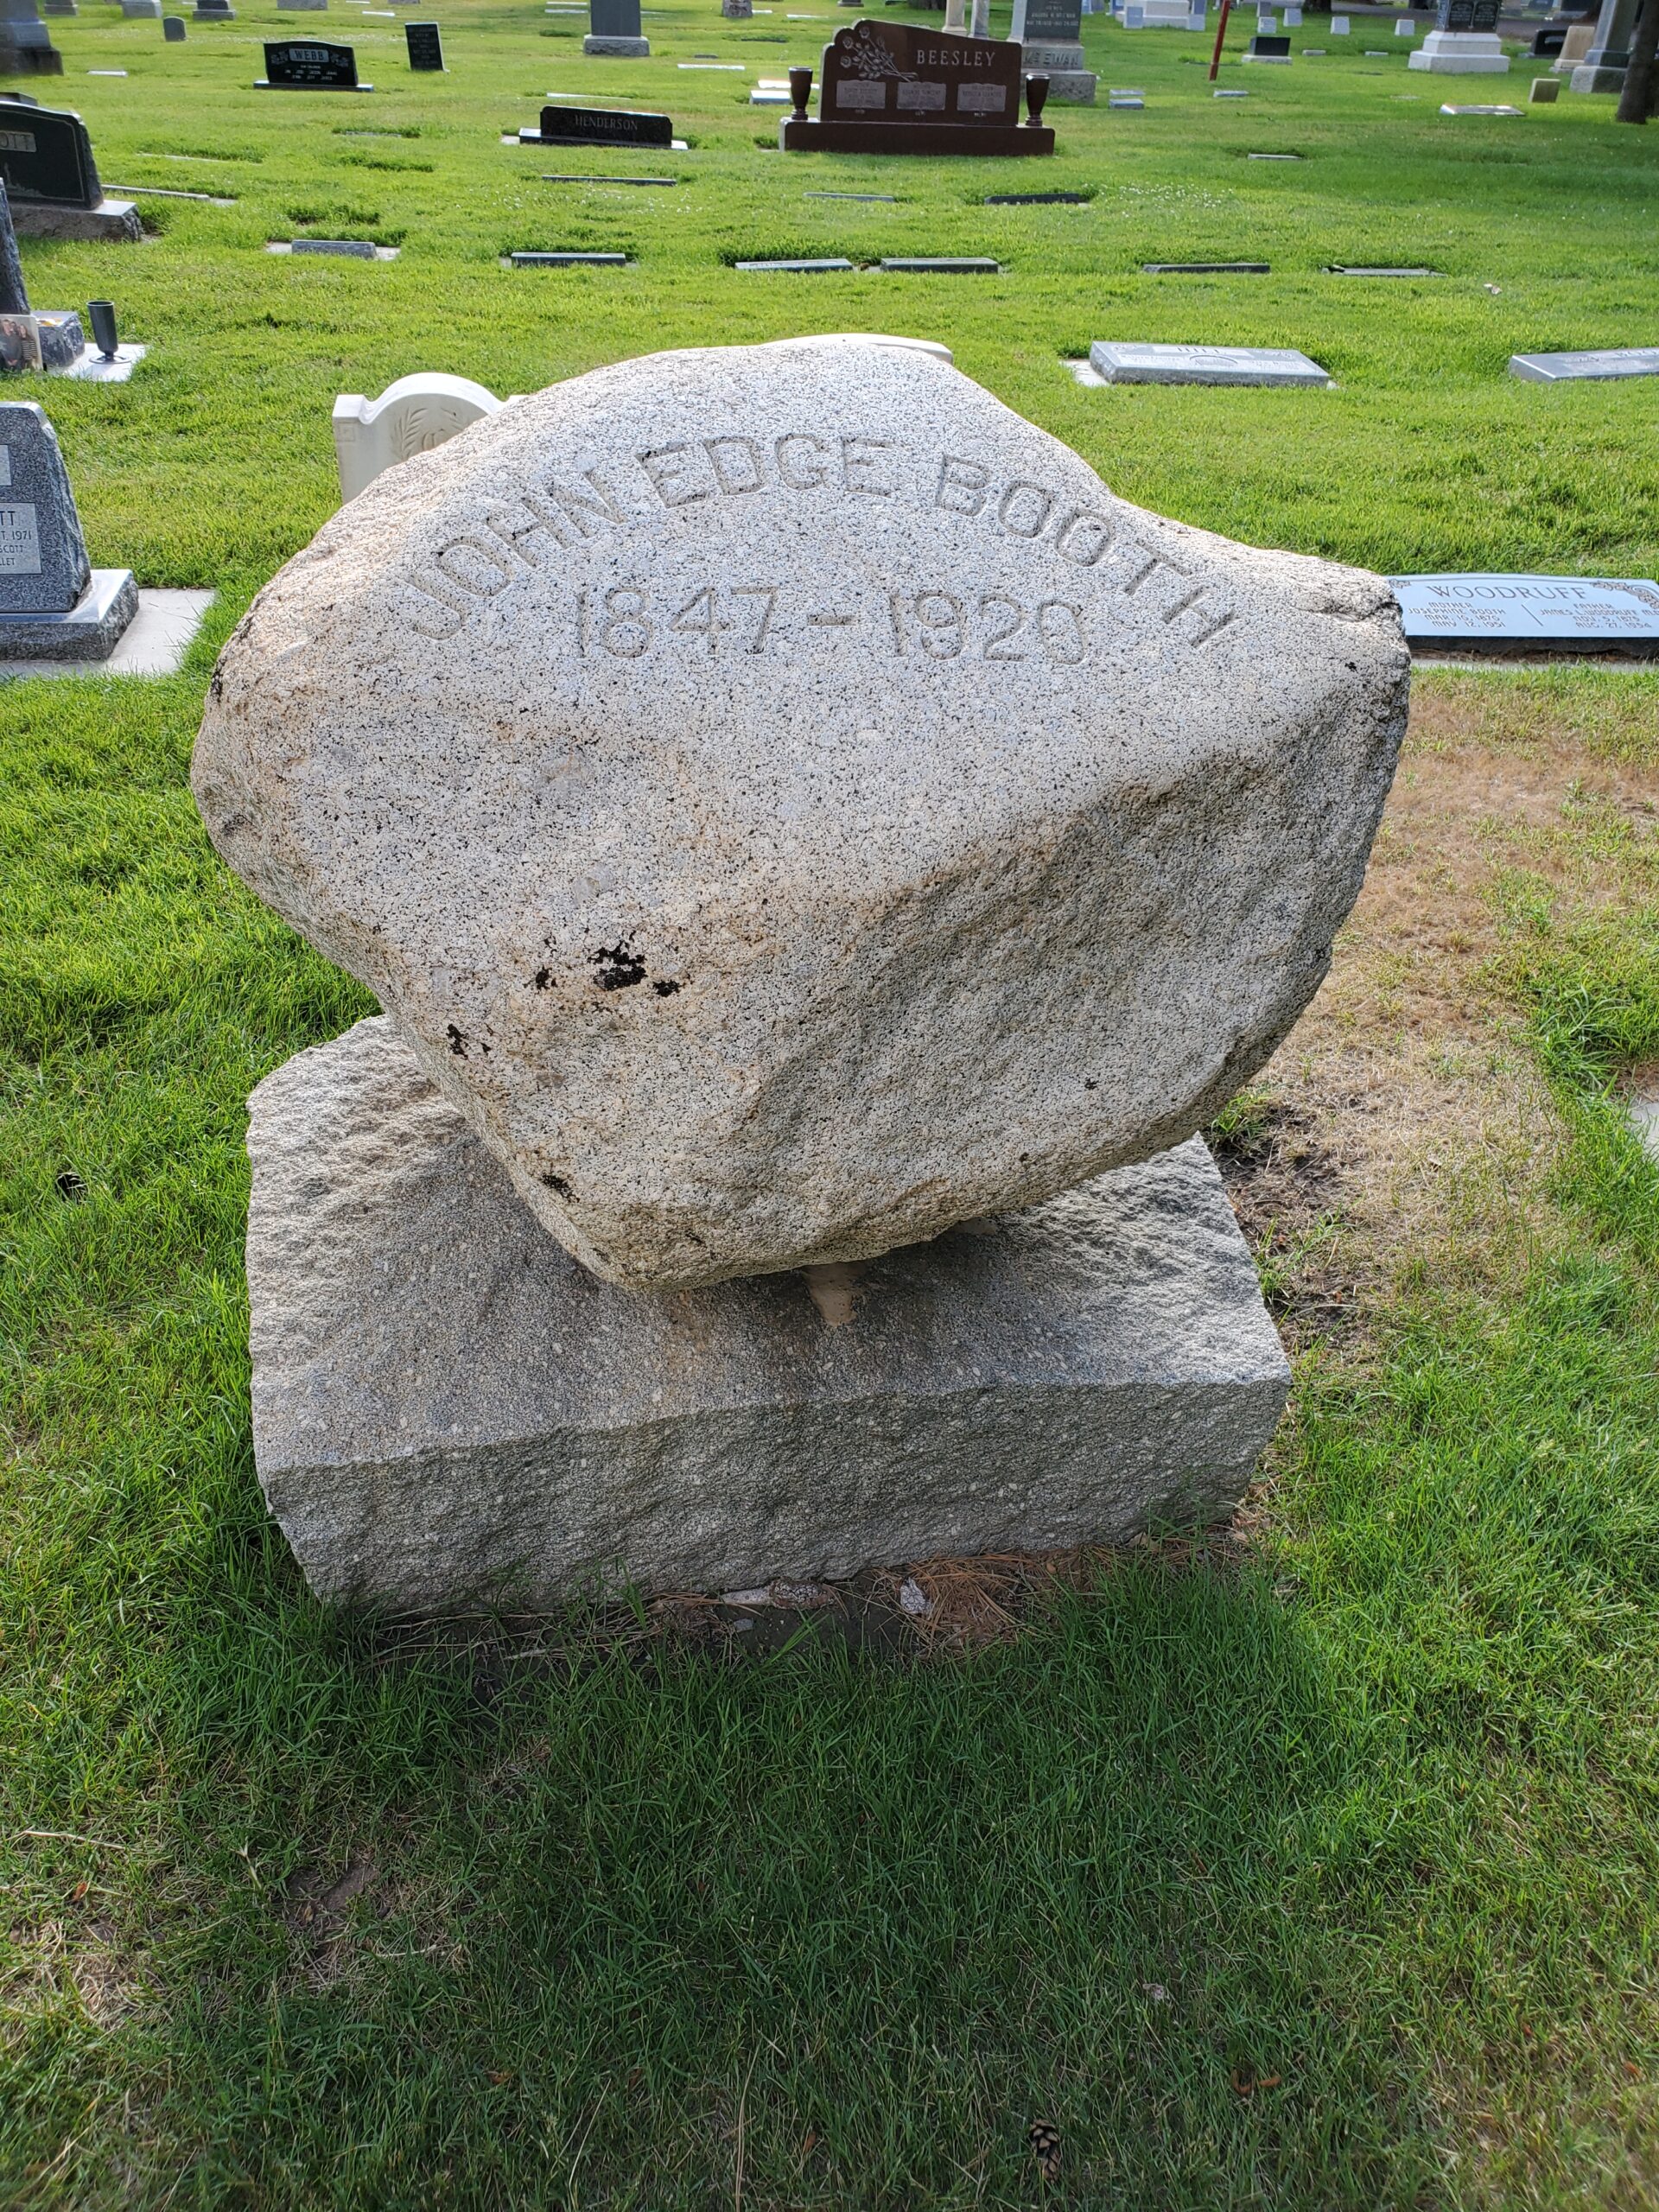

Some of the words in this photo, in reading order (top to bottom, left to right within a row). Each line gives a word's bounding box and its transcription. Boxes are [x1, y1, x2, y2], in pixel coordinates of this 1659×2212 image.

[295, 49, 323, 61] WEBB
[917, 49, 995, 67] BEESLEY
[575, 114, 638, 130] HENDERSON
[12, 531, 32, 541] 1971
[392, 462, 629, 641] JOHN
[633, 433, 895, 509] EDGE
[935, 454, 1241, 649] BOOTH
[1425, 585, 1587, 600] WOODRUFF
[576, 586, 779, 659] 1847
[888, 587, 1084, 664] 1920
